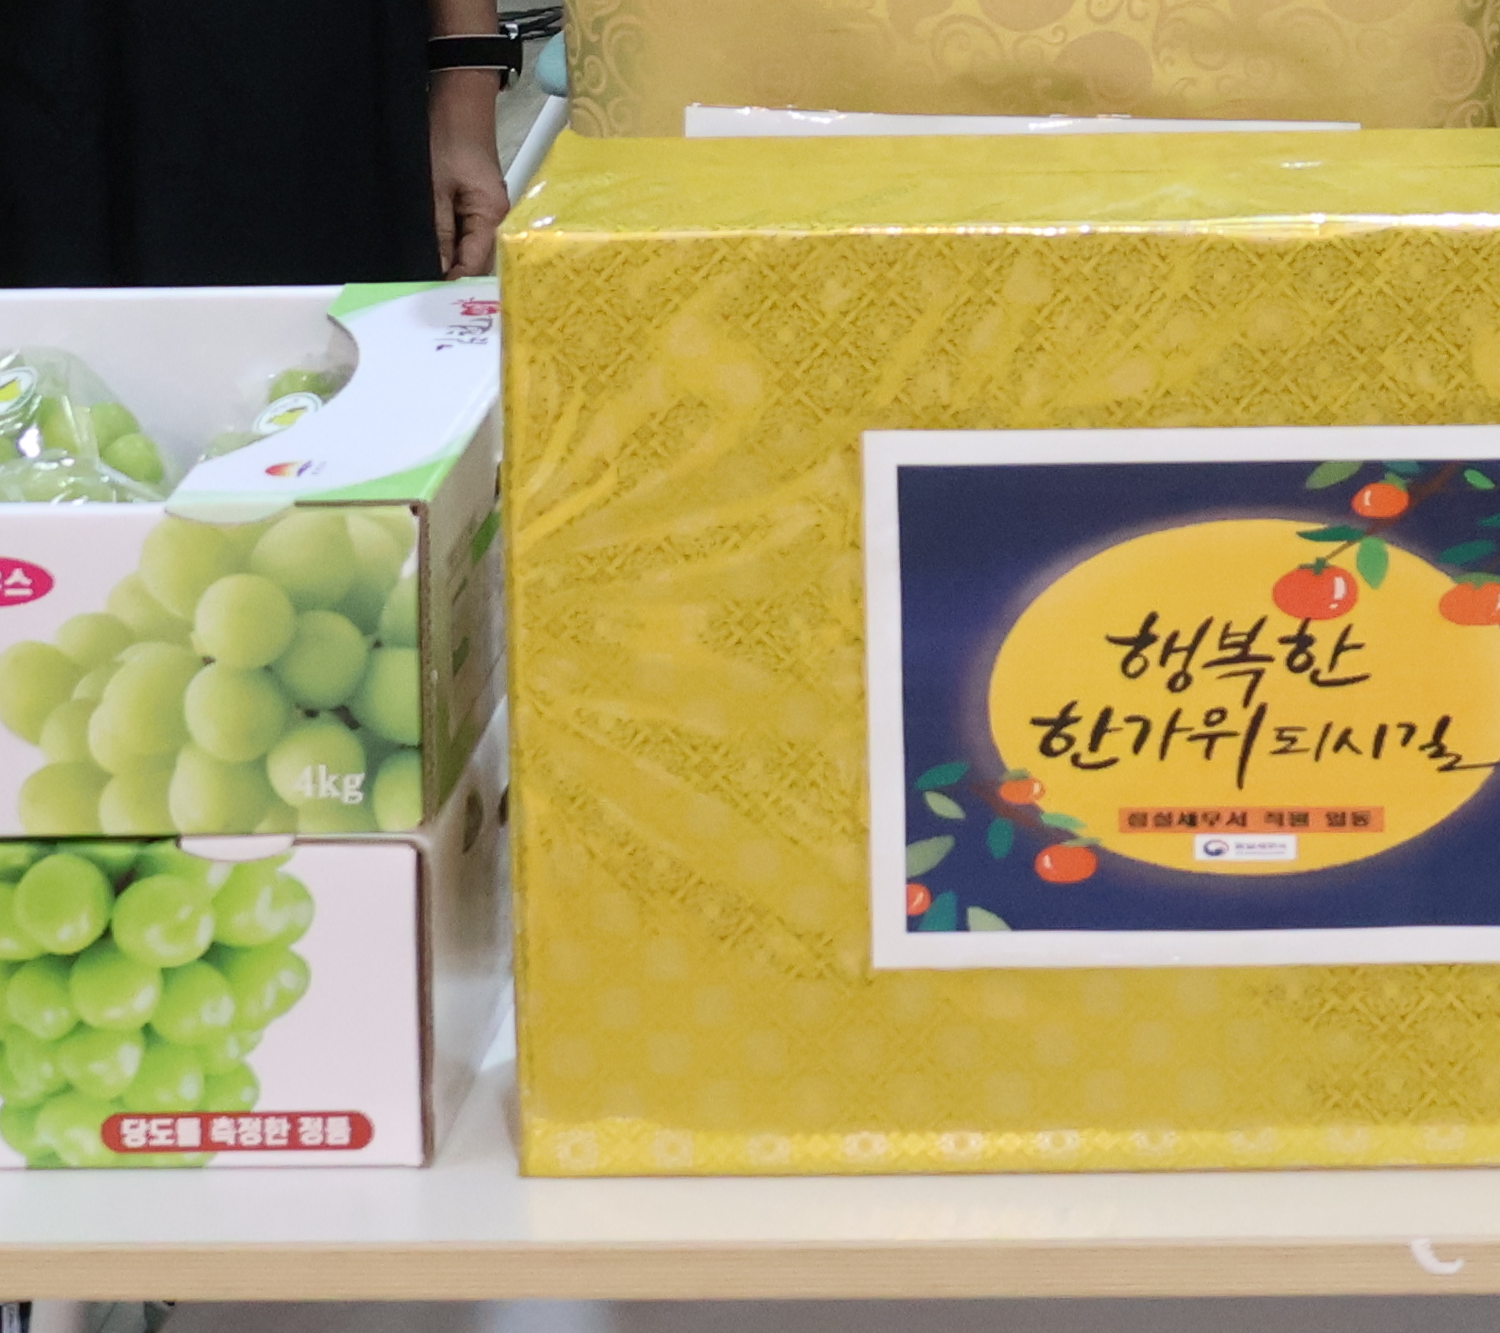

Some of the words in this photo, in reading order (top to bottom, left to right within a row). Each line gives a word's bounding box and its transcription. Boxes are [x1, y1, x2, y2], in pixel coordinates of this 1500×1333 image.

[1105, 612, 1371, 708] 행복한
[291, 763, 366, 805] 4kg
[1030, 701, 1269, 789] 한가위
